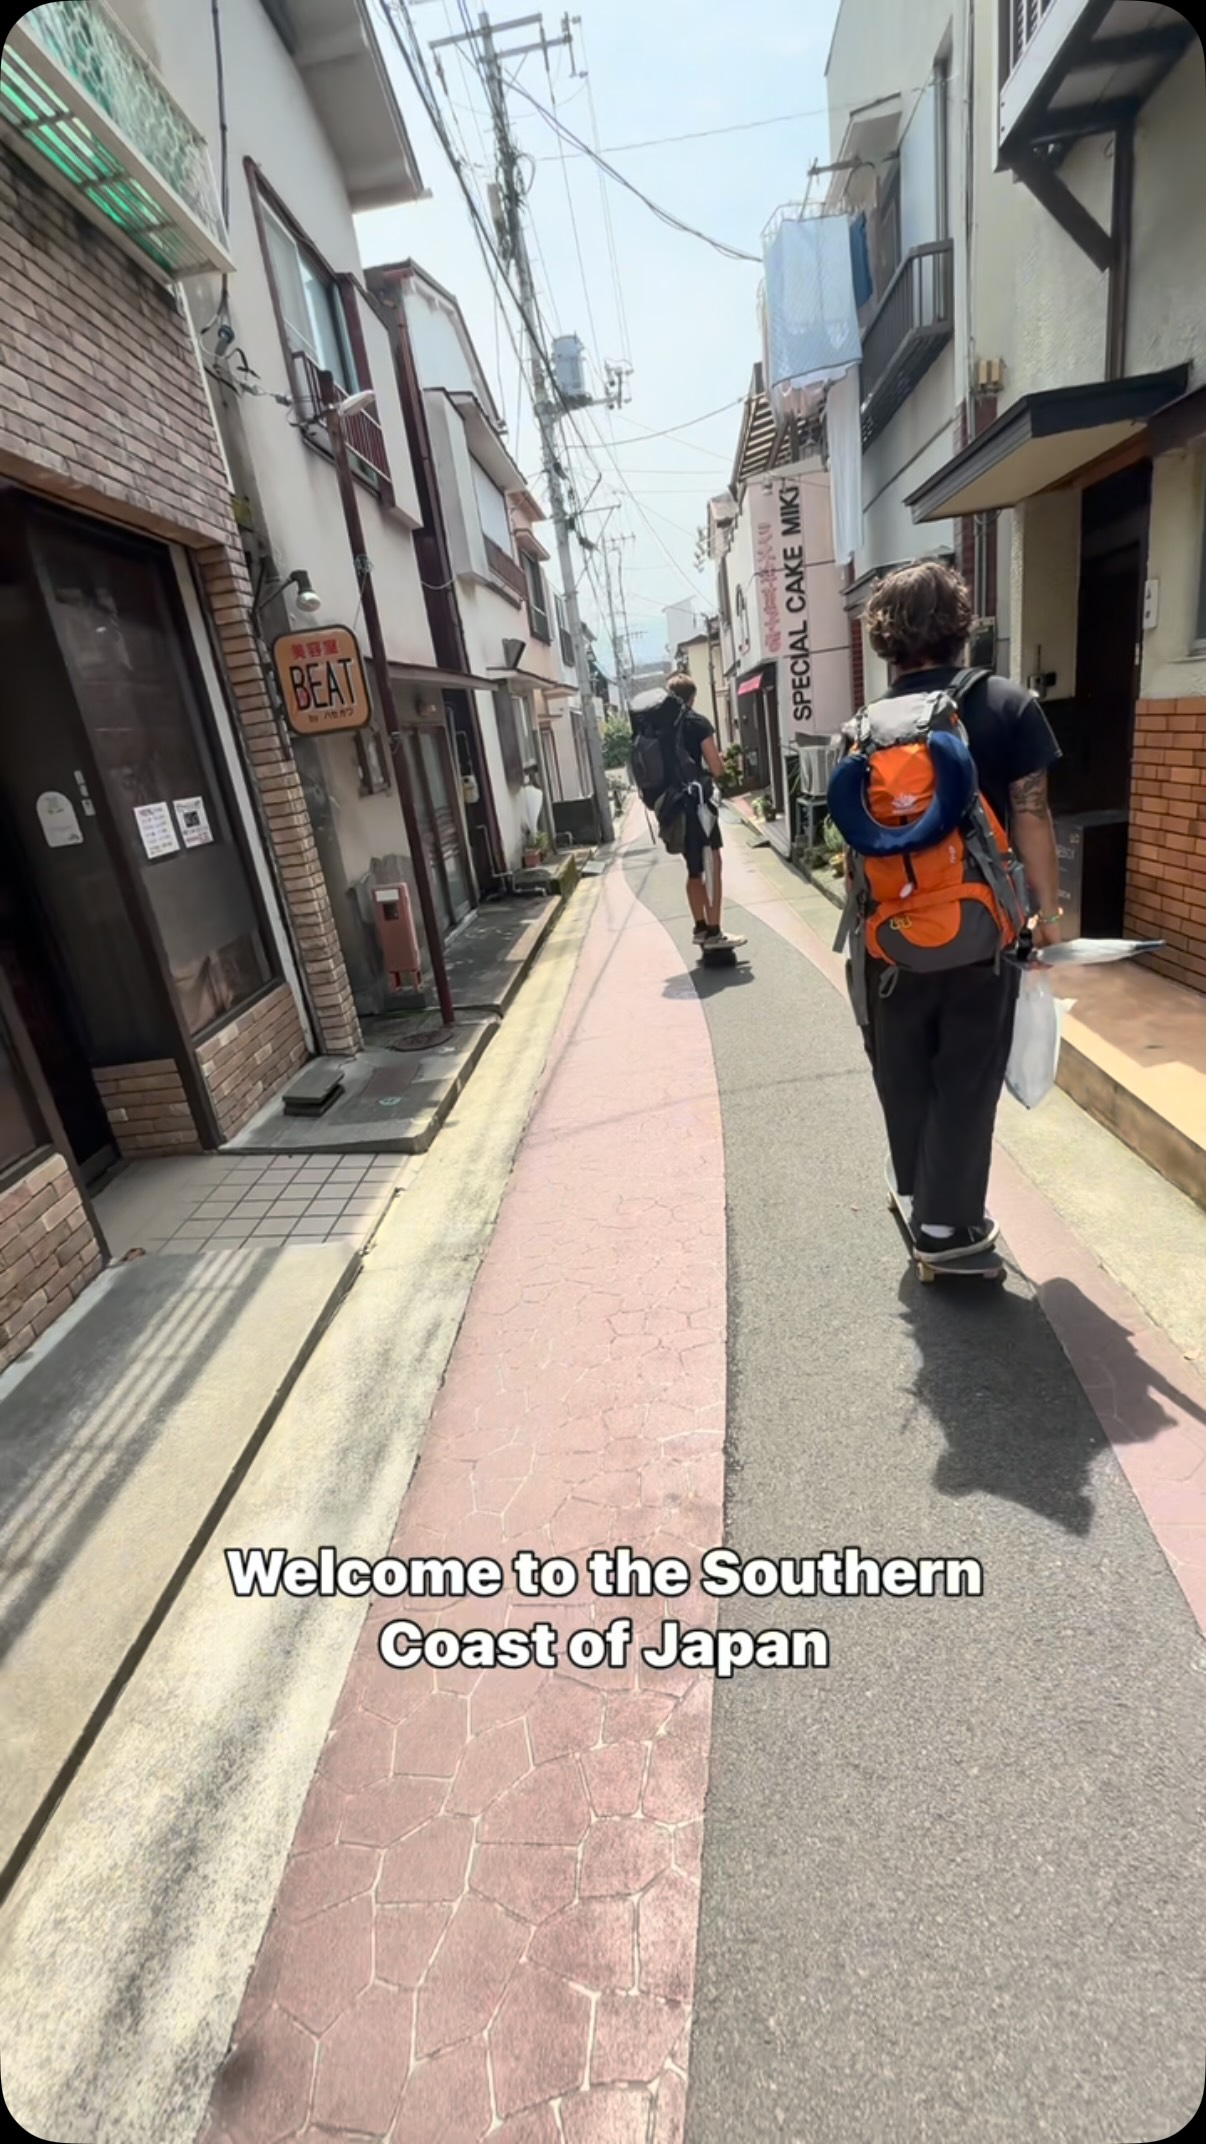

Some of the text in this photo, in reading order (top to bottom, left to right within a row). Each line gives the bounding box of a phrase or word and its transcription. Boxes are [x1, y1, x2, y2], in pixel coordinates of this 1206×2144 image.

[783, 545, 806, 613] CAKE
[288, 658, 355, 710] BEAT
[788, 619, 812, 721] SPECIAL
